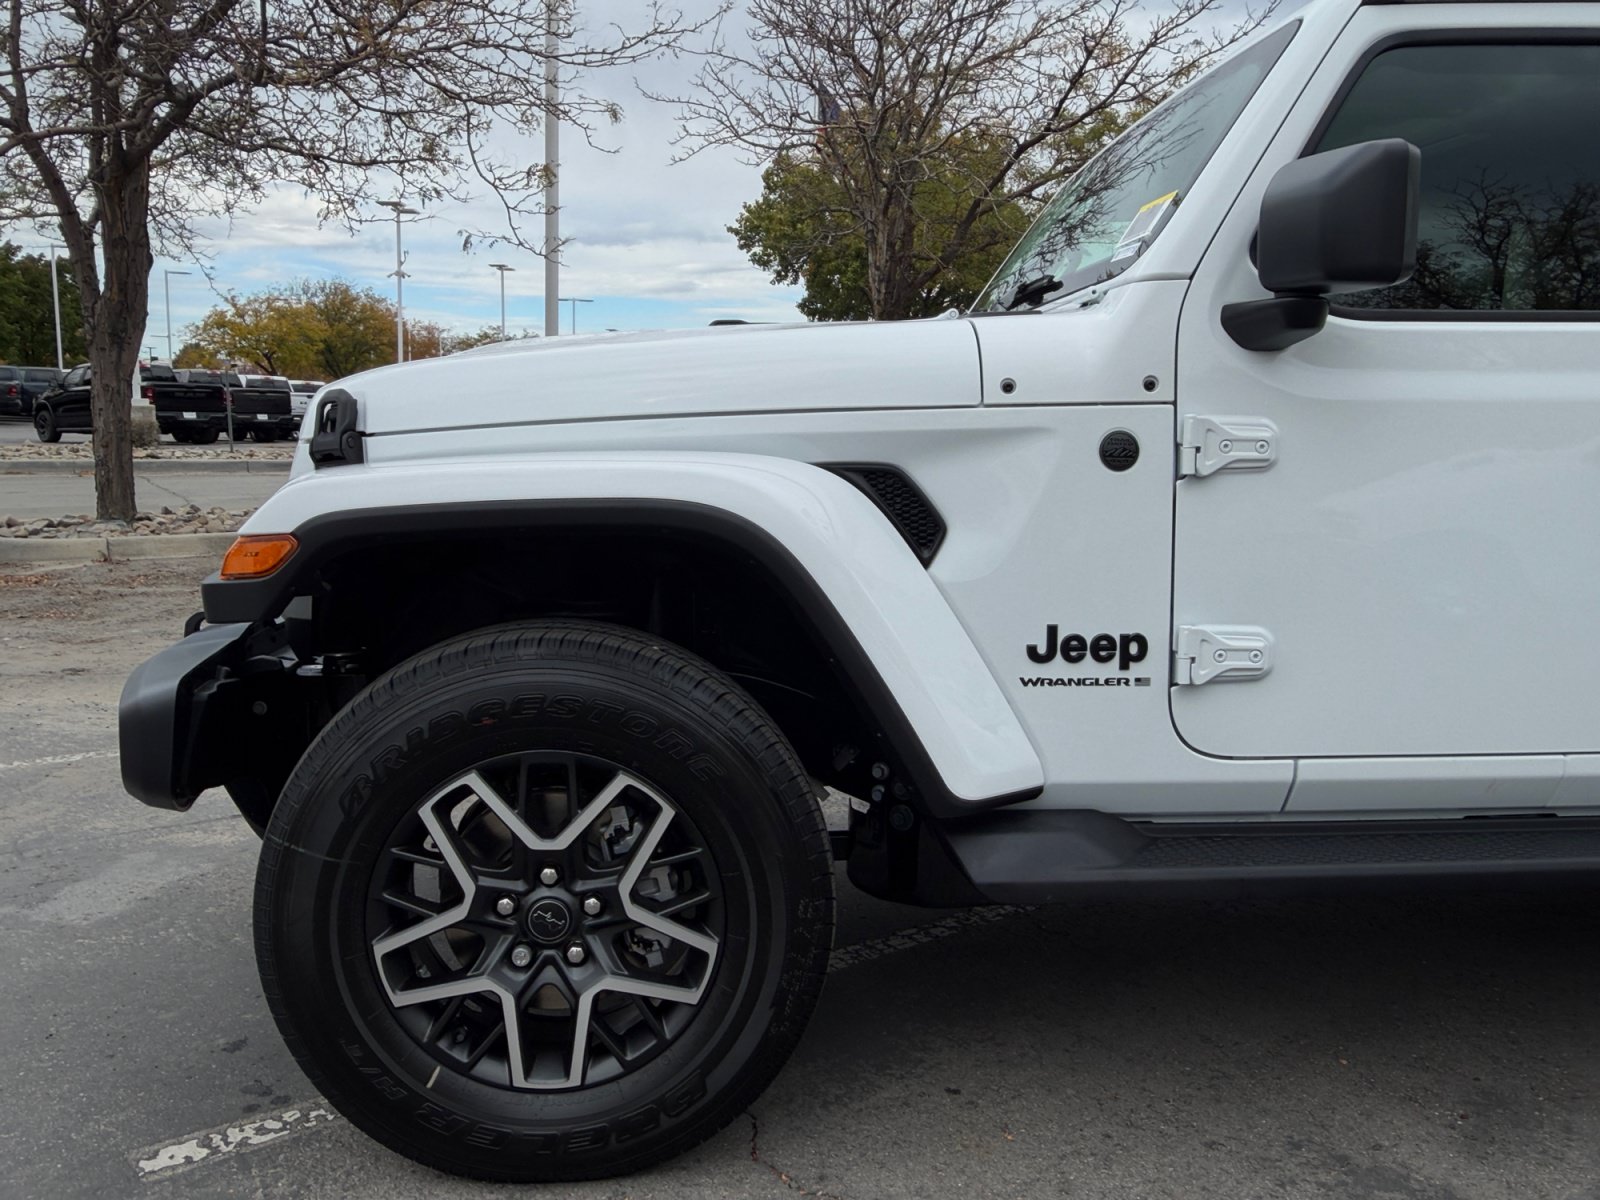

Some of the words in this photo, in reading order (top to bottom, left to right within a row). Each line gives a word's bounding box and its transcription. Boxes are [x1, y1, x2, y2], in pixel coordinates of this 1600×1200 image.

[1026, 624, 1149, 670] Jeep
[1019, 677, 1131, 687] WRANGLER
[338, 692, 729, 818] BRIDGESTONE
[414, 1068, 708, 1155] DUELER
